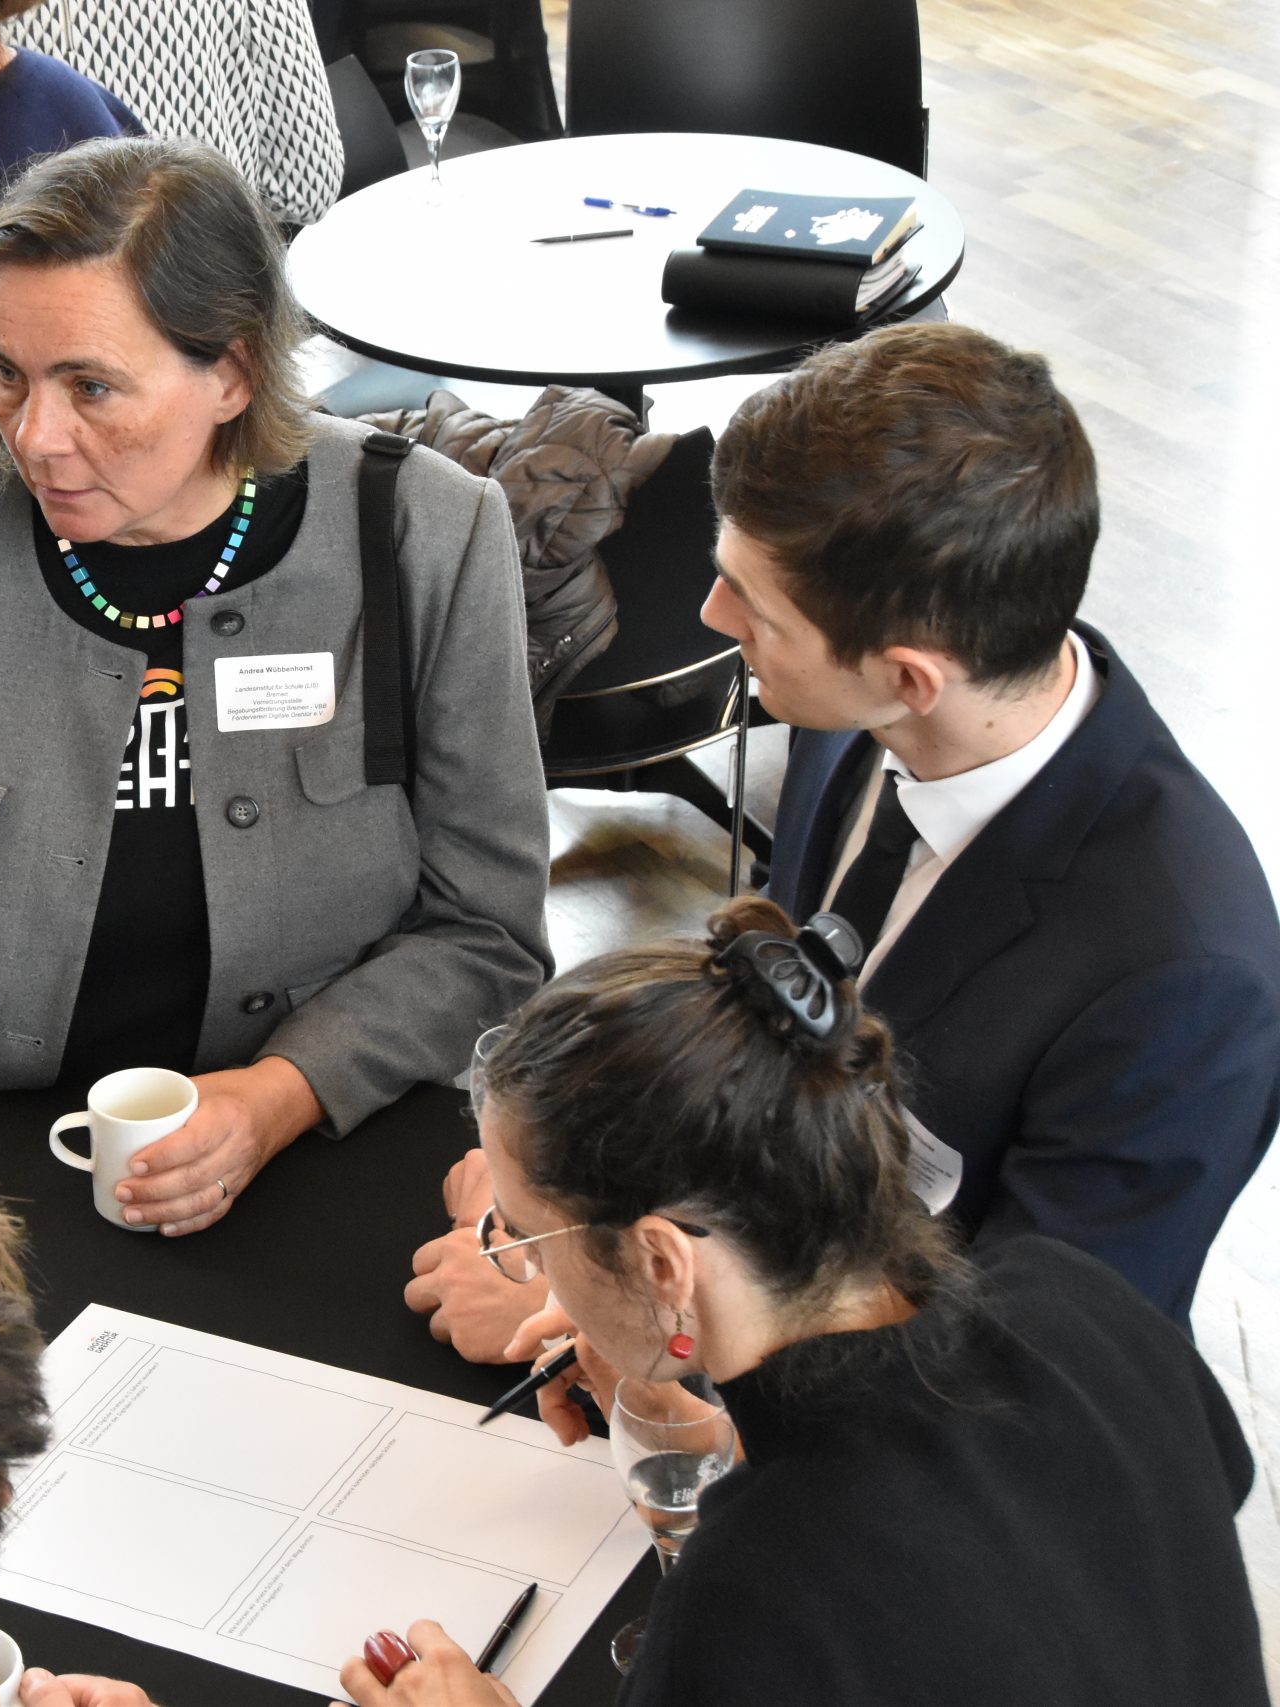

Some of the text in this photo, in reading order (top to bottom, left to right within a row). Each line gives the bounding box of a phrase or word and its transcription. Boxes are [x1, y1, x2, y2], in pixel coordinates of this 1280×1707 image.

[266, 665, 313, 673] Wübbenhorst
[235, 684, 274, 692] Landesinstitut
[269, 712, 289, 720] Digitale
